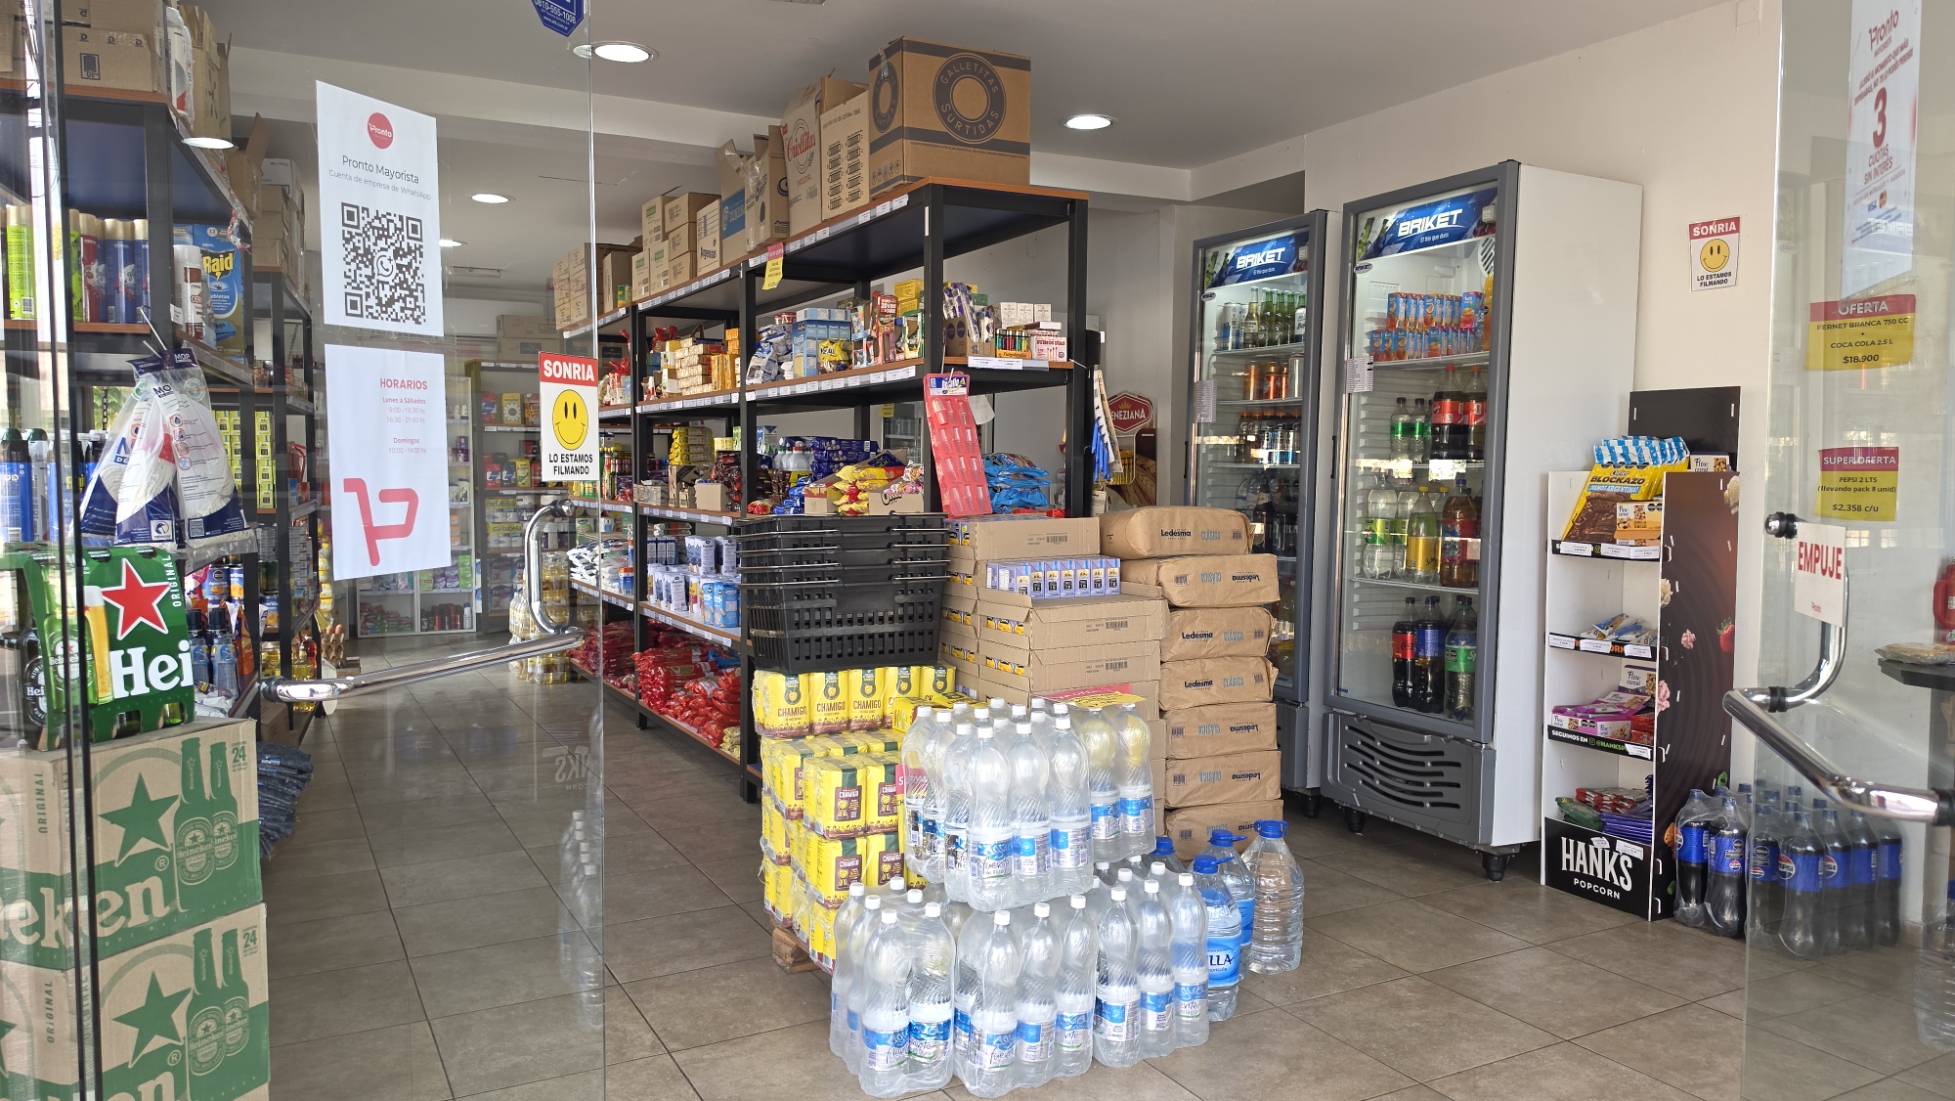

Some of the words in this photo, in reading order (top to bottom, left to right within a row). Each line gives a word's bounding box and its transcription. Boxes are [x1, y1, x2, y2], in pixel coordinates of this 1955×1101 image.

[1869, 9, 1899, 52] Pronto
[940, 61, 999, 93] GALLETITAS
[941, 103, 999, 136] SURTIDAS
[1873, 87, 1888, 148] 3
[368, 123, 393, 138] Pronto
[342, 155, 374, 173] Pronto
[376, 164, 419, 184] Mayorista
[329, 169, 353, 181] Cuenta
[354, 175, 362, 183] de
[363, 178, 390, 190] empresa
[391, 184, 399, 192] de
[401, 186, 431, 200] WhatsApp
[1398, 208, 1463, 237] BRIKET
[1693, 221, 1737, 237] SONRIA
[202, 253, 234, 274] Raid
[1236, 247, 1286, 269] BRIKET
[1697, 274, 1704, 282] LO
[1706, 271, 1732, 281] ESTAMOS
[1700, 278, 1728, 287] FILMANDO
[1838, 300, 1889, 316] OFERTA
[1816, 321, 1847, 331] FERNET
[1849, 319, 1882, 329] BRANCA
[1883, 318, 1896, 326] 750
[1830, 341, 1853, 349] COCA
[1854, 340, 1876, 348] COLA
[1842, 354, 1879, 364] $18.900
[543, 359, 595, 382] SONRIA
[380, 378, 428, 390] HORARIOS
[1110, 408, 1146, 420] ENEZIANA
[549, 453, 558, 463] LO
[560, 453, 593, 464] ESTAMOS
[1823, 456, 1854, 465] SUPER
[1858, 456, 1896, 464] OFERTA
[553, 465, 590, 476] FILMANDO
[1590, 476, 1646, 485] BLOCKAZO
[1817, 485, 1852, 493] (llevando
[1832, 503, 1862, 512] $2.358
[1864, 504, 1878, 512] c/u
[1161, 529, 1191, 537] Ledesma
[1797, 541, 1842, 580] EMPUJE
[162, 555, 182, 608] ORIGINAL
[1232, 573, 1260, 582] Ledesma
[1182, 631, 1213, 640] Ledesma
[1184, 679, 1213, 688] Ledesma
[778, 706, 808, 717] CHAMIGO
[816, 701, 846, 713] CHAMIGO
[853, 700, 881, 710] CHAMIGO
[1230, 724, 1259, 733] Ledesma
[1551, 730, 1579, 741] SEGUINOS
[231, 746, 246, 763] 24
[1231, 772, 1261, 781] Ledesma
[34, 772, 48, 834] ORIGINAL
[1560, 836, 1633, 892] HANKS
[1573, 878, 1621, 900] POPCORN
[0, 876, 170, 949] eken
[243, 930, 258, 948] 24
[44, 981, 54, 1044] ORIGINAL
